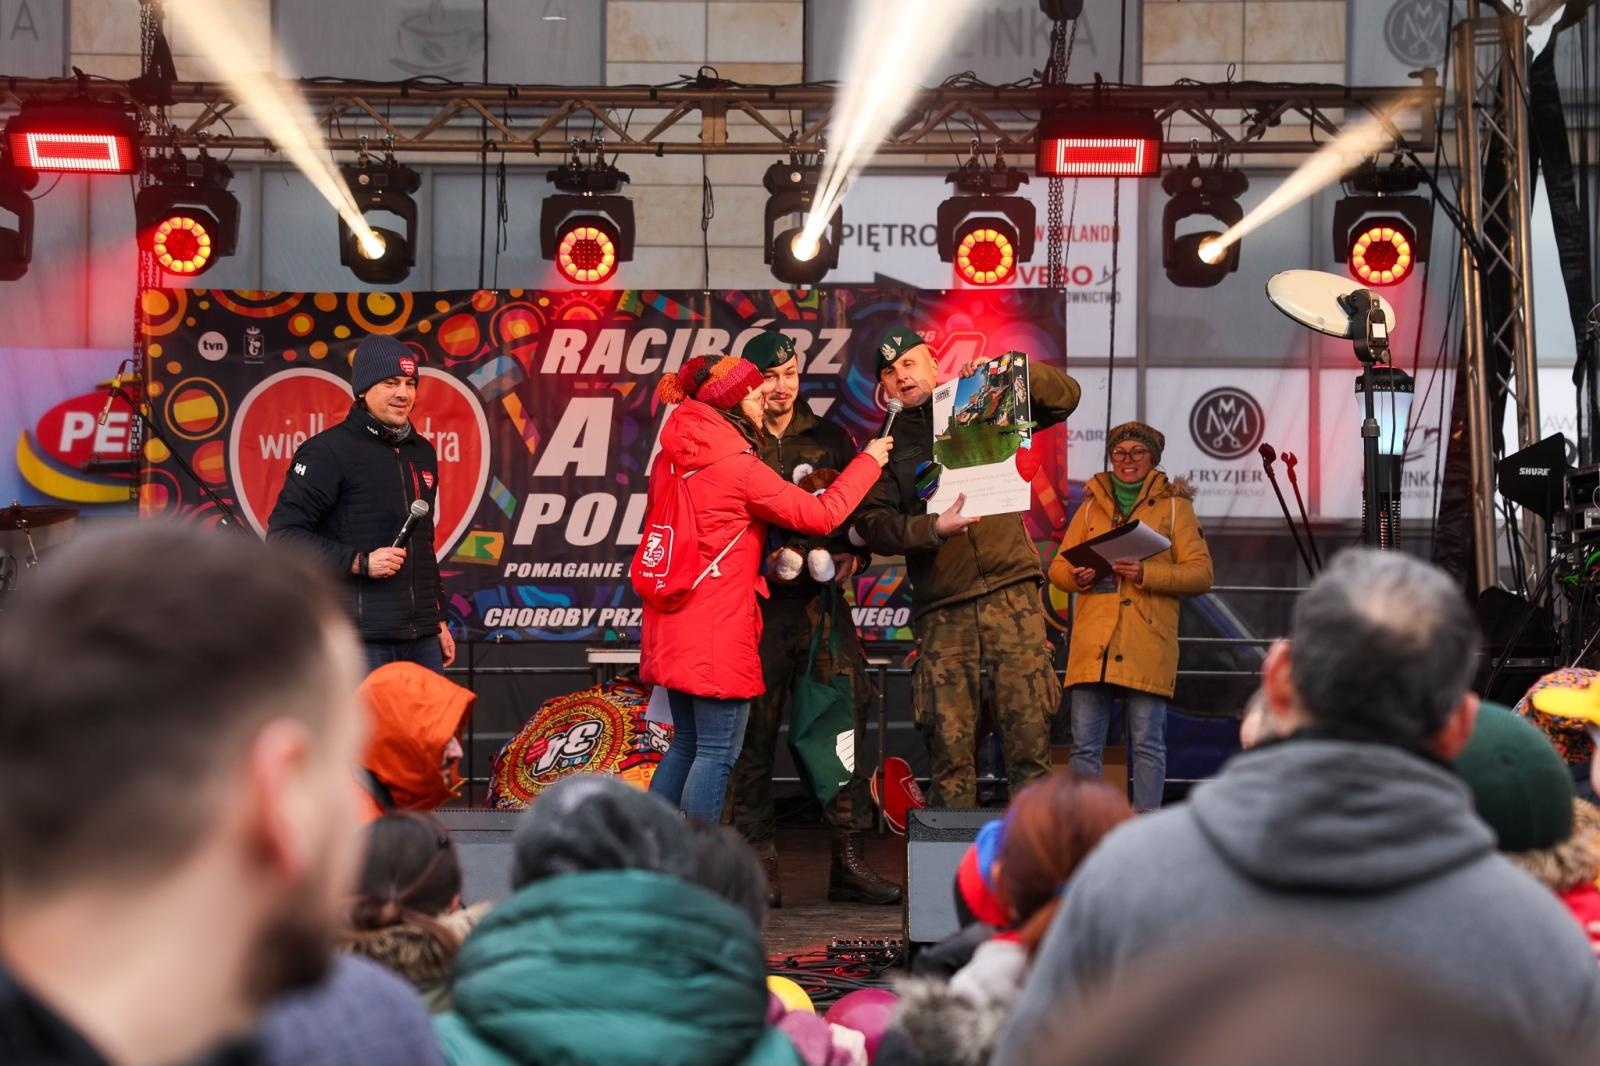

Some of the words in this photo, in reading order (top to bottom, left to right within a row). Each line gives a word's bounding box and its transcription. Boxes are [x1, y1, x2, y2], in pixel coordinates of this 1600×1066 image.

[841, 223, 938, 252] PIĘTRO
[203, 341, 223, 350] tvn
[533, 397, 614, 476] A
[1189, 468, 1263, 485] FRYZJER
[1519, 467, 1550, 476] SHURE
[504, 562, 624, 578] POMAGANIE
[484, 607, 596, 627] CHOROBY
